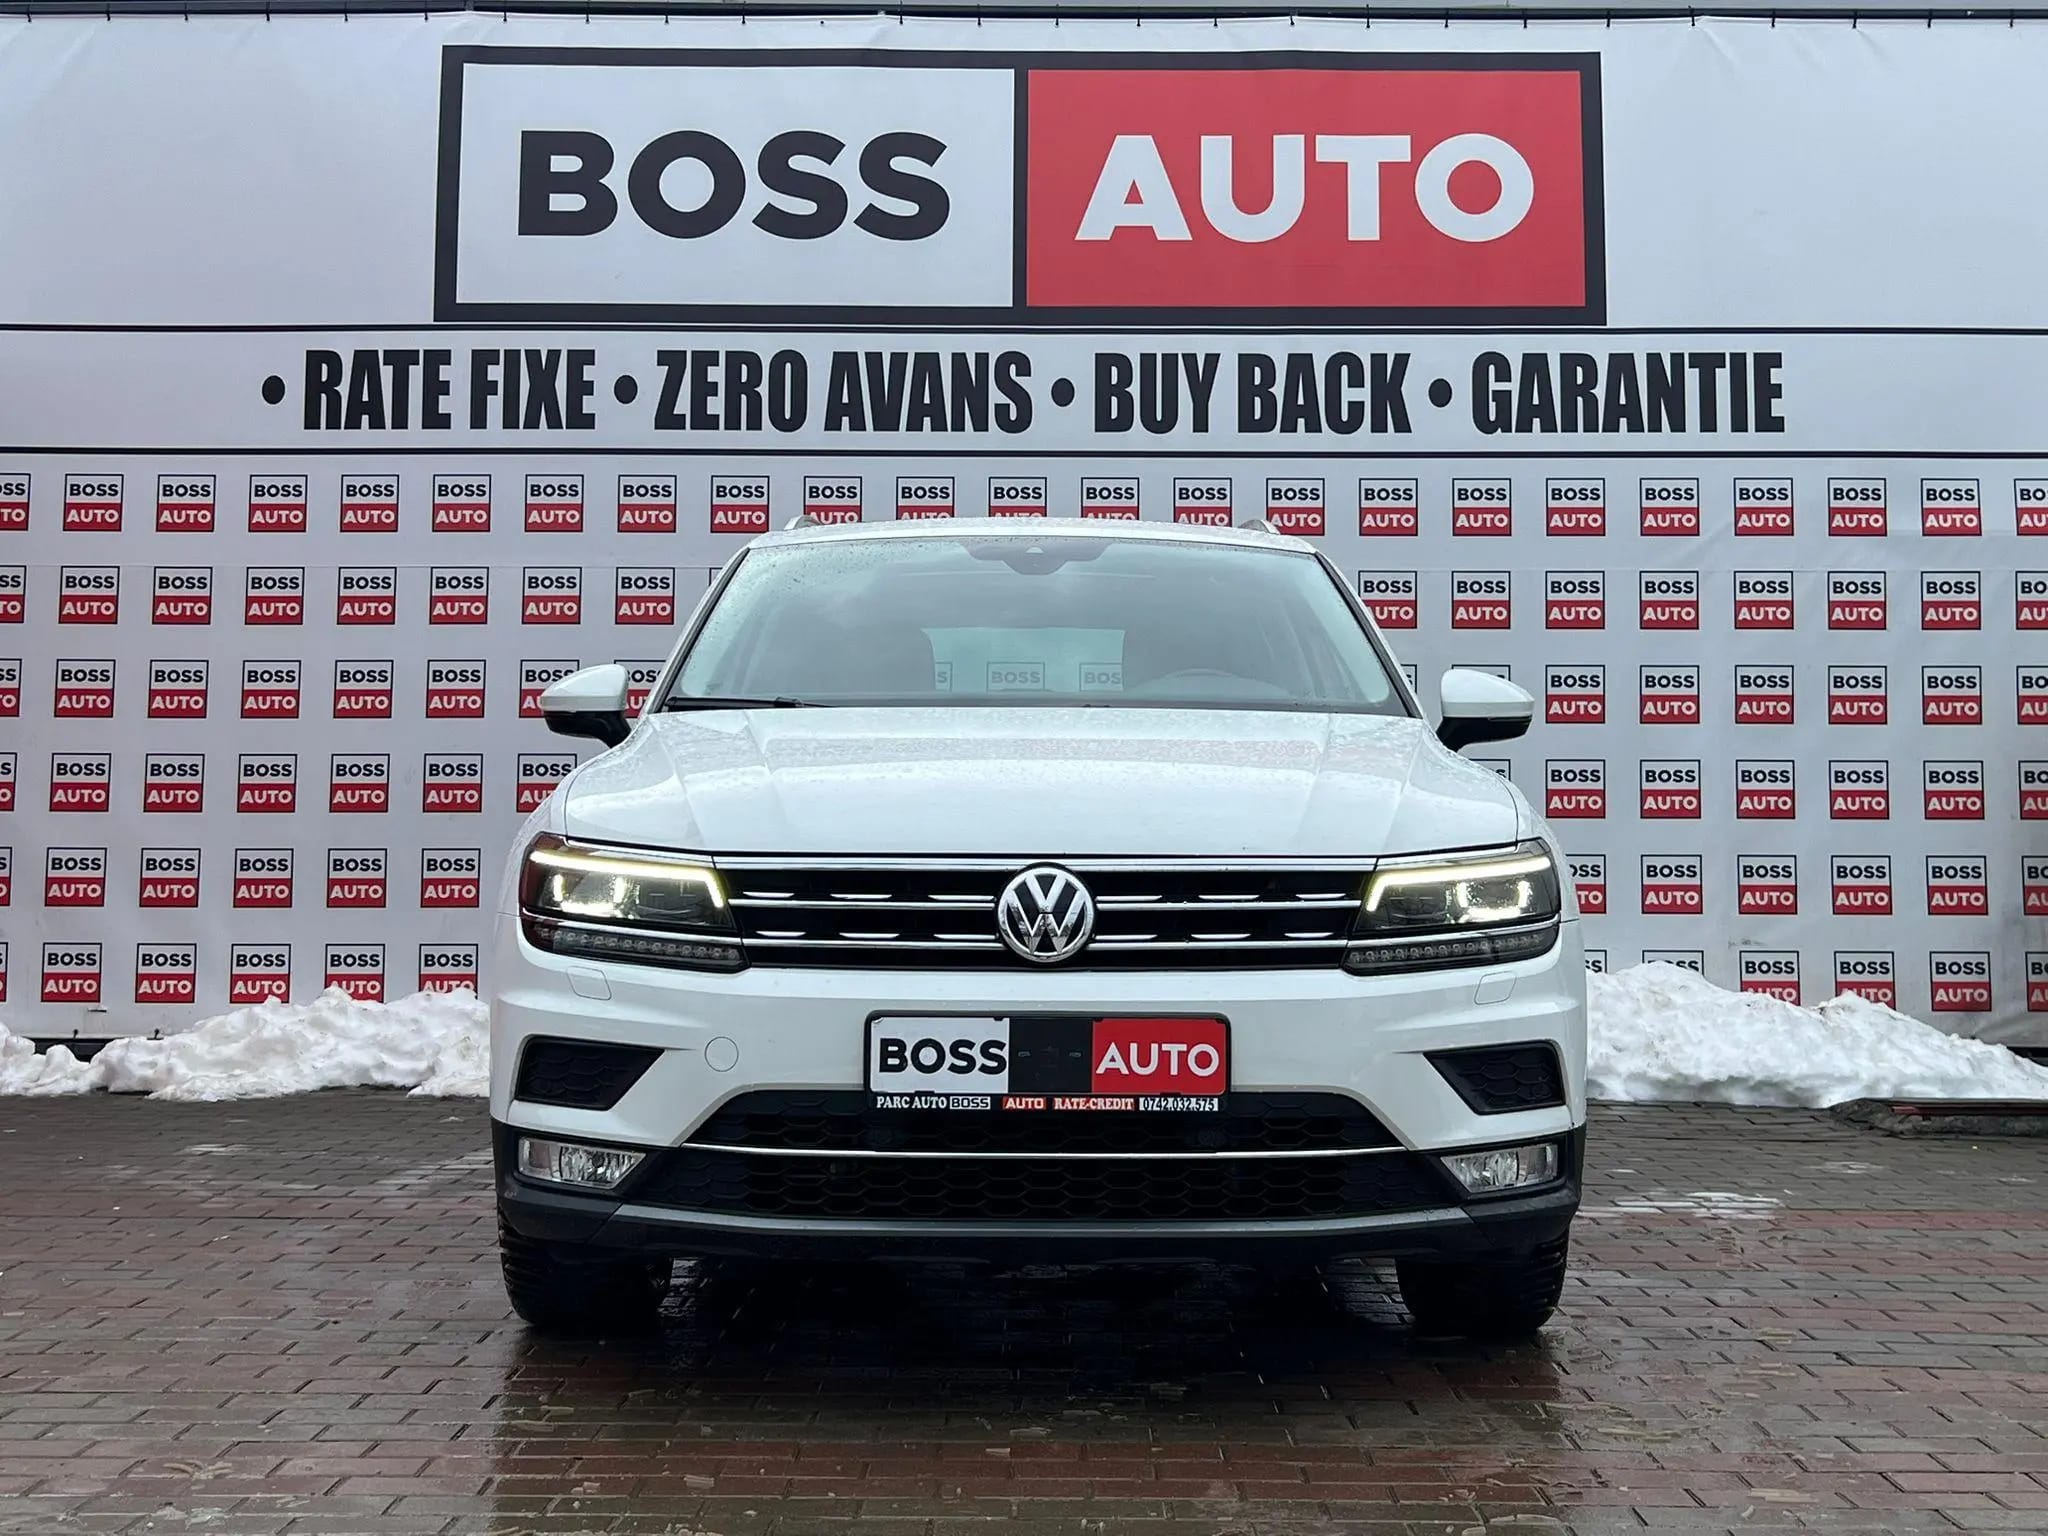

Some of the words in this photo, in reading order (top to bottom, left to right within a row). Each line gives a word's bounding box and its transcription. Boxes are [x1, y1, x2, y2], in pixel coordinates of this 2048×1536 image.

[518, 131, 949, 240] BOSS
[1075, 133, 1534, 242] AUTO
[304, 349, 451, 430] RATE
[470, 349, 595, 429] FIXE
[654, 350, 807, 432] ZERO
[824, 351, 1032, 433] AVANS
[1095, 353, 1220, 434] BUY
[1238, 352, 1412, 434] BACK
[1472, 352, 1784, 434] GARANTIE
[70, 484, 118, 496] BOSS
[163, 485, 210, 497] BOSS
[255, 485, 302, 497] BOSS
[346, 485, 394, 497] BOSS
[438, 484, 486, 497] BOSS
[531, 484, 578, 497] BOSS
[623, 485, 672, 497] BOSS
[716, 486, 764, 498] BOSS
[809, 486, 857, 498] BOSS
[902, 487, 950, 499] BOSS
[994, 487, 1042, 499] BOSS
[1087, 487, 1134, 499] BOSS
[1179, 488, 1227, 500] BOSS
[1272, 488, 1320, 500] BOSS
[1365, 488, 1413, 500] BOSS
[1458, 488, 1506, 500] BOSS
[1552, 488, 1600, 500] BOSS
[1646, 488, 1694, 500] BOSS
[1739, 488, 1788, 500] BOSS
[1834, 488, 1881, 500] BOSS
[1927, 489, 1975, 501] BOSS
[67, 510, 118, 522] AUTO
[160, 510, 211, 523] AUTO
[252, 511, 303, 523] AUTO
[344, 510, 394, 523] AUTO
[436, 510, 487, 523] AUTO
[528, 510, 579, 523] AUTO
[621, 511, 672, 523] AUTO
[714, 511, 765, 524] AUTO
[1363, 514, 1414, 527] AUTO
[1456, 514, 1508, 527] AUTO
[1550, 514, 1602, 527] AUTO
[1644, 514, 1696, 527] AUTO
[1738, 514, 1790, 527] AUTO
[1832, 514, 1883, 527] AUTO
[1926, 514, 1977, 527] AUTO
[66, 576, 114, 588] BOSS
[159, 577, 207, 589] BOSS
[251, 577, 299, 589] BOSS
[344, 577, 391, 589] BOSS
[436, 576, 483, 589] BOSS
[528, 576, 576, 589] BOSS
[621, 577, 670, 589] BOSS
[1364, 581, 1412, 593] BOSS
[1457, 581, 1506, 593] BOSS
[1551, 581, 1600, 593] BOSS
[1645, 581, 1694, 593] BOSS
[1740, 581, 1788, 593] BOSS
[1833, 581, 1881, 594] BOSS
[1927, 581, 1976, 594] BOSS
[62, 602, 114, 615] AUTO
[156, 603, 207, 615] AUTO
[248, 603, 299, 616] AUTO
[341, 603, 392, 615] AUTO
[433, 602, 484, 615] AUTO
[526, 602, 577, 615] AUTO
[619, 603, 670, 615] AUTO
[1456, 607, 1507, 620] AUTO
[1549, 607, 1601, 620] AUTO
[1643, 607, 1695, 620] AUTO
[1738, 607, 1790, 620] AUTO
[1832, 608, 1883, 620] AUTO
[1925, 608, 1977, 621] AUTO
[61, 669, 110, 682] BOSS
[155, 670, 203, 682] BOSS
[248, 670, 295, 682] BOSS
[340, 670, 388, 682] BOSS
[432, 670, 480, 682] BOSS
[991, 671, 1041, 684] BOSS
[1551, 675, 1600, 688] BOSS
[1645, 675, 1694, 688] BOSS
[1740, 675, 1789, 688] BOSS
[1834, 676, 1882, 688] BOSS
[1928, 676, 1977, 688] BOSS
[58, 695, 110, 708] AUTO
[152, 696, 203, 709] AUTO
[244, 696, 296, 709] AUTO
[337, 696, 388, 709] AUTO
[429, 696, 481, 708] AUTO
[1549, 701, 1601, 714] AUTO
[1643, 702, 1696, 715] AUTO
[1739, 702, 1790, 715] AUTO
[1832, 702, 1883, 715] AUTO
[1926, 702, 1978, 715] AUTO
[57, 763, 105, 776] BOSS
[151, 764, 199, 776] BOSS
[244, 764, 292, 776] BOSS
[336, 764, 384, 776] BOSS
[429, 764, 478, 776] BOSS
[1551, 770, 1600, 782] BOSS
[1646, 770, 1695, 782] BOSS
[1741, 770, 1790, 783] BOSS
[1835, 771, 1884, 783] BOSS
[1929, 771, 1979, 783] BOSS
[53, 789, 105, 802] AUTO
[147, 790, 199, 803] AUTO
[241, 790, 292, 803] AUTO
[333, 790, 385, 803] AUTO
[426, 790, 478, 803] AUTO
[1549, 796, 1602, 809] AUTO
[1644, 796, 1697, 809] AUTO
[1740, 796, 1791, 809] AUTO
[1834, 797, 1885, 810] AUTO
[1928, 797, 1980, 810] AUTO
[51, 858, 101, 870] BOSS
[146, 858, 195, 871] BOSS
[240, 859, 288, 871] BOSS
[333, 859, 382, 871] BOSS
[427, 859, 475, 871] BOSS
[1647, 865, 1697, 877] BOSS
[1743, 865, 1792, 878] BOSS
[1837, 866, 1886, 878] BOSS
[1932, 866, 1982, 879] BOSS
[48, 884, 101, 897] AUTO
[143, 885, 195, 898] AUTO
[237, 885, 289, 898] AUTO
[330, 885, 383, 898] AUTO
[424, 885, 476, 898] AUTO
[1645, 891, 1699, 905] AUTO
[1742, 892, 1793, 905] AUTO
[1836, 892, 1888, 905] AUTO
[1931, 893, 1984, 906] AUTO
[48, 953, 96, 966] BOSS
[142, 954, 191, 966] BOSS
[236, 954, 285, 967] BOSS
[331, 954, 380, 967] BOSS
[1745, 961, 1794, 974] BOSS
[1936, 962, 1985, 975] BOSS
[44, 980, 97, 993] AUTO
[138, 980, 191, 993] AUTO
[233, 981, 286, 994] AUTO
[1935, 989, 1987, 1002] AUTO
[878, 1038, 1007, 1075] BOSS
[1096, 1042, 1220, 1077] AUTO
[876, 1096, 910, 1109] PARC
[911, 1096, 948, 1109] AUTO
[952, 1098, 989, 1109] BOSS
[1005, 1097, 1044, 1109] AUTO
[1054, 1097, 1134, 1110] RATE-CREDIT
